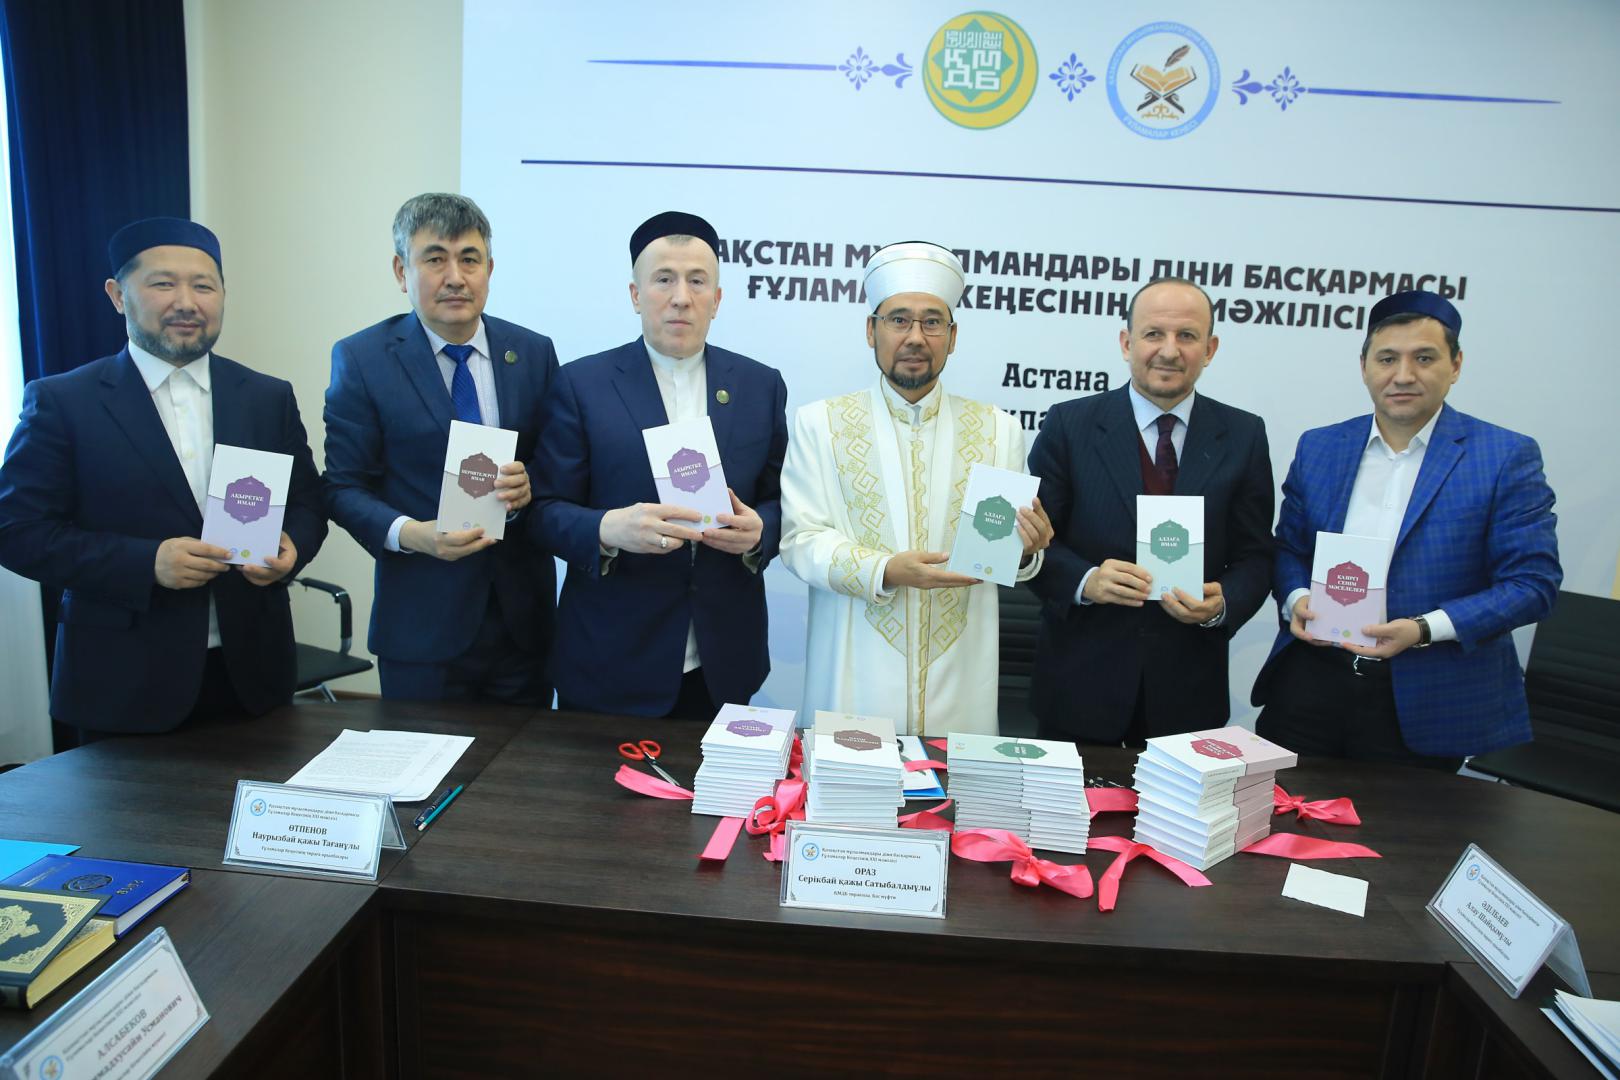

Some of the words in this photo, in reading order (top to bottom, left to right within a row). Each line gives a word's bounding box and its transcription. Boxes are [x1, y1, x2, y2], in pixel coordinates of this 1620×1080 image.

[718, 239, 833, 268] АҚСТАН
[845, 244, 1141, 282] МЛМАНДАРЫ
[1150, 259, 1233, 287] ДІНИ
[1244, 264, 1467, 301] БАСҚАРМАСЫ
[748, 275, 867, 304] ҒҰЛАМ
[1002, 363, 1109, 392] Астана
[252, 831, 297, 845] Наурызбай
[297, 837, 320, 848] қажы
[322, 839, 360, 851] Тағанұлы
[288, 824, 328, 836] ӨТПЕНОВ
[798, 874, 837, 885] Серікбай
[838, 878, 863, 887] қажы
[864, 879, 931, 893] Сатыбалдыұлы
[854, 867, 877, 877] ОРАЗ
[97, 1008, 147, 1060] АЛСАБЕКОВ
